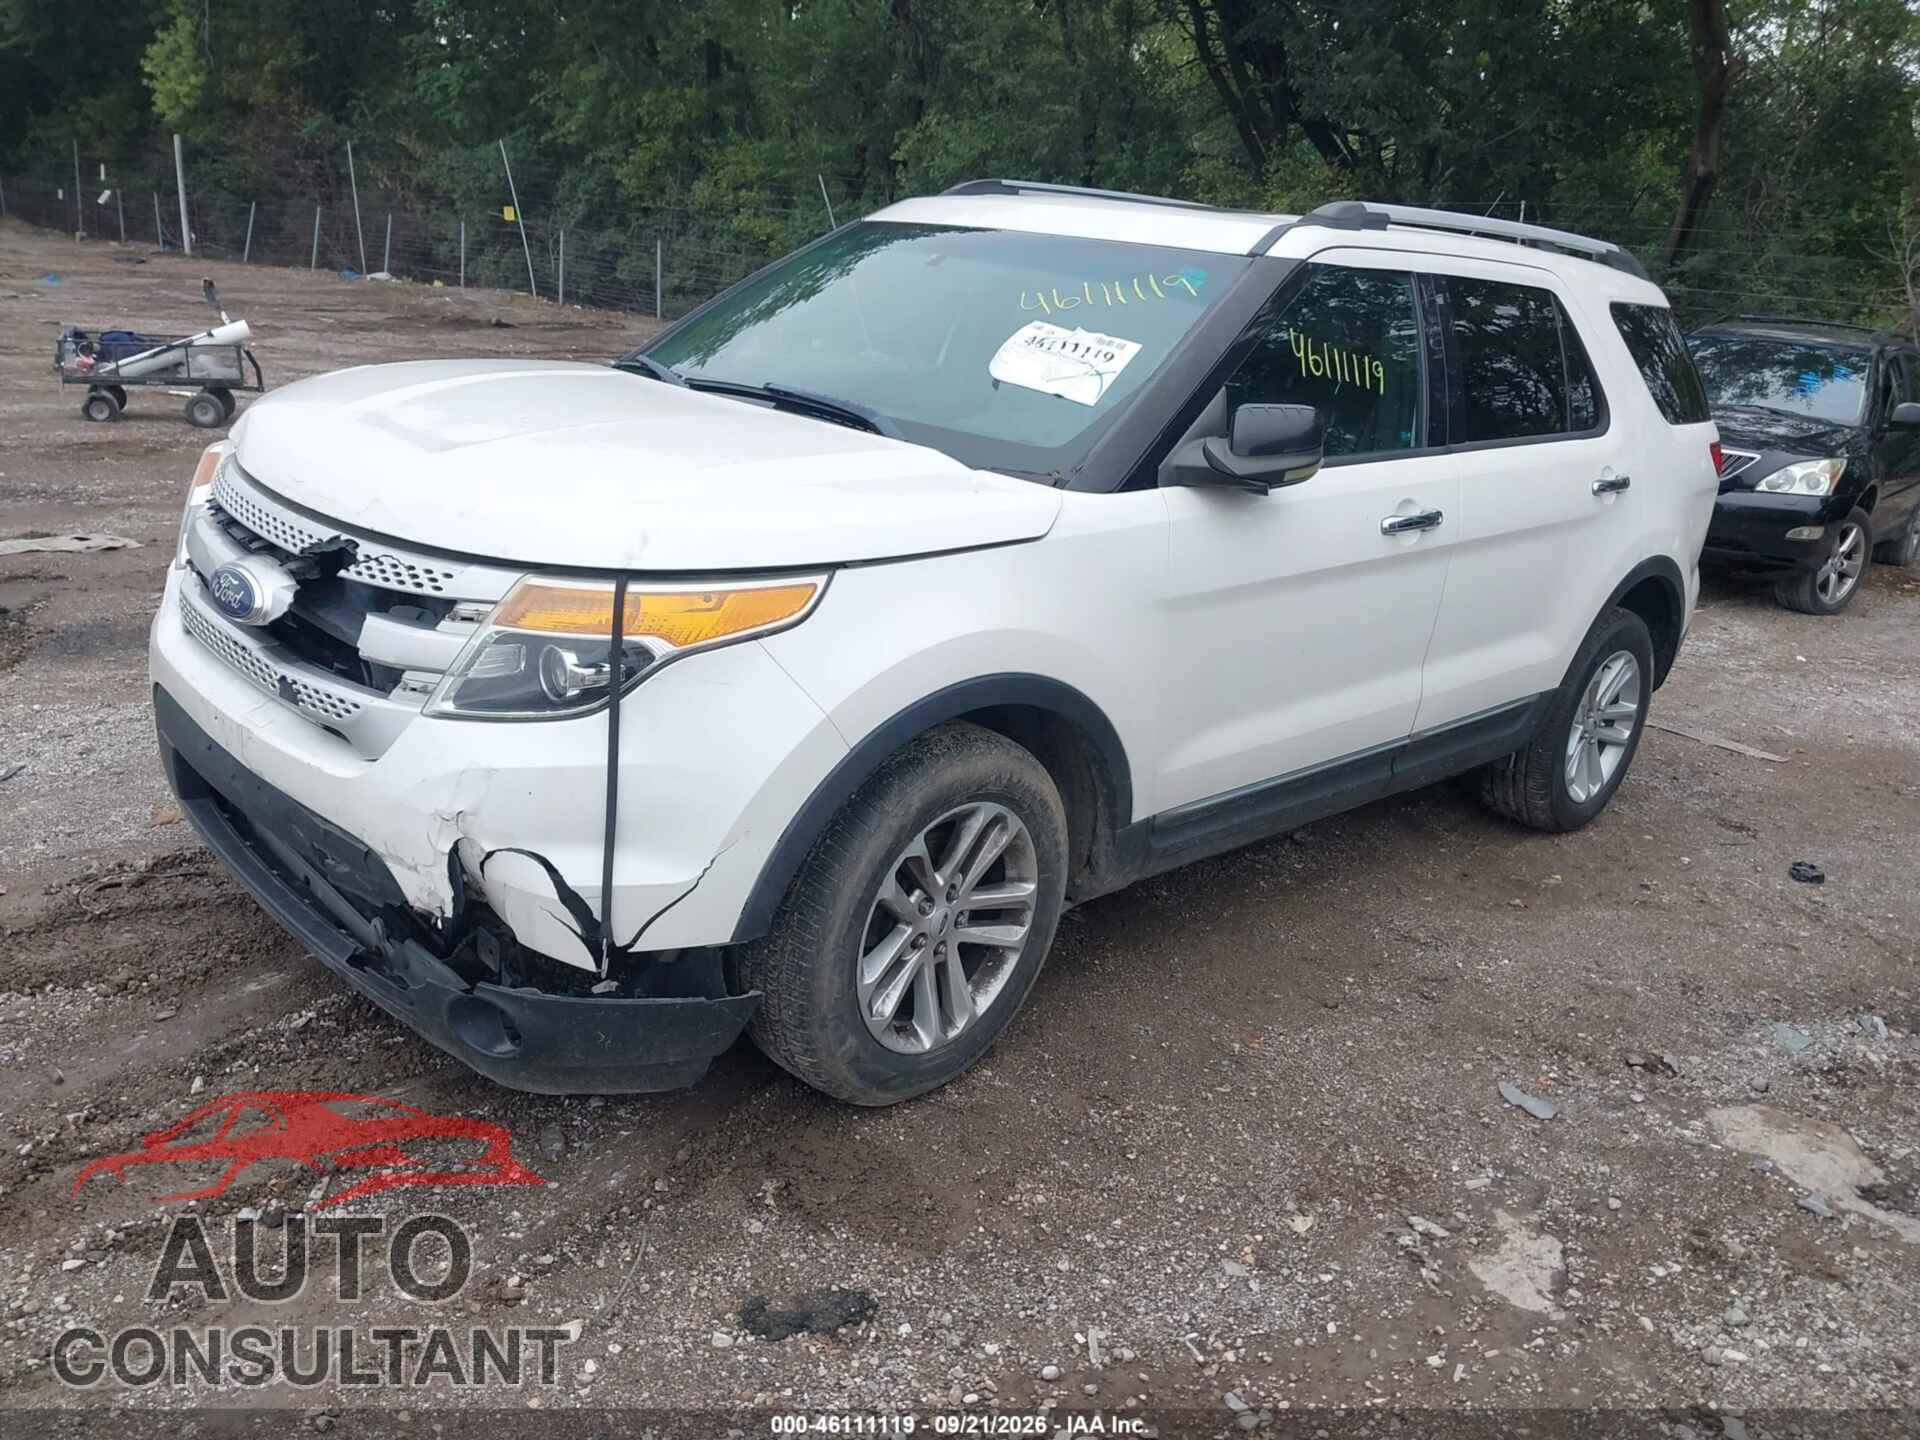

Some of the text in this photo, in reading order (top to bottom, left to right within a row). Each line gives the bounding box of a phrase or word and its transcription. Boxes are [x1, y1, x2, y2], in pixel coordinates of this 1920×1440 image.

[1020, 274, 1198, 315] 46111119
[1289, 327, 1384, 395] 46111119
[213, 573, 244, 609] Ford
